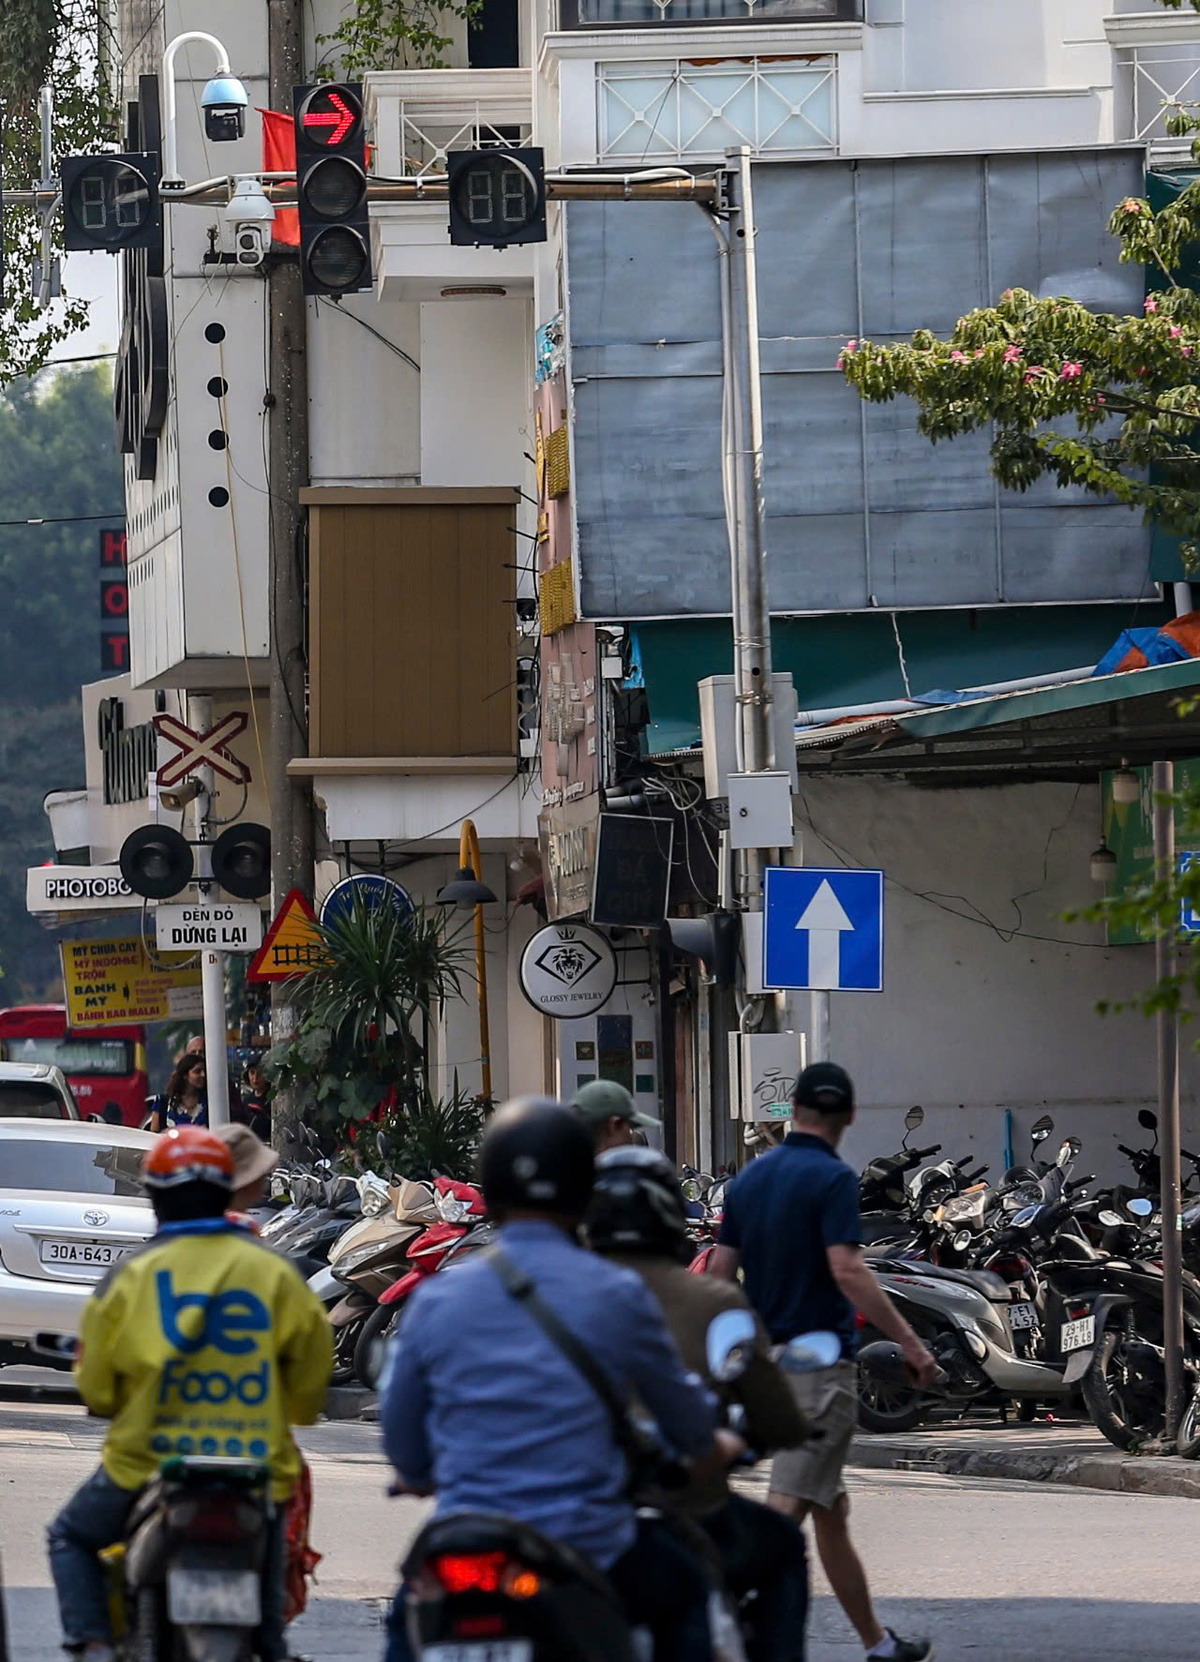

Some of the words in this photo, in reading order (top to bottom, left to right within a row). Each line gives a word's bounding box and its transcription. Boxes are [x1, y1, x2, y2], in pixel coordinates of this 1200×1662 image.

[183, 908, 210, 921] ĐÈN
[214, 905, 234, 921] ĐỎ
[172, 923, 217, 944] DỪNG
[222, 927, 247, 947] LẠI
[541, 994, 568, 1003] GLOSSY
[570, 991, 603, 1001] JEWELRY
[156, 1270, 272, 1356] be
[1007, 1304, 1030, 1318] 7-E1
[1065, 1318, 1090, 1337] 29-H1
[1063, 1330, 1092, 1351] 976.48
